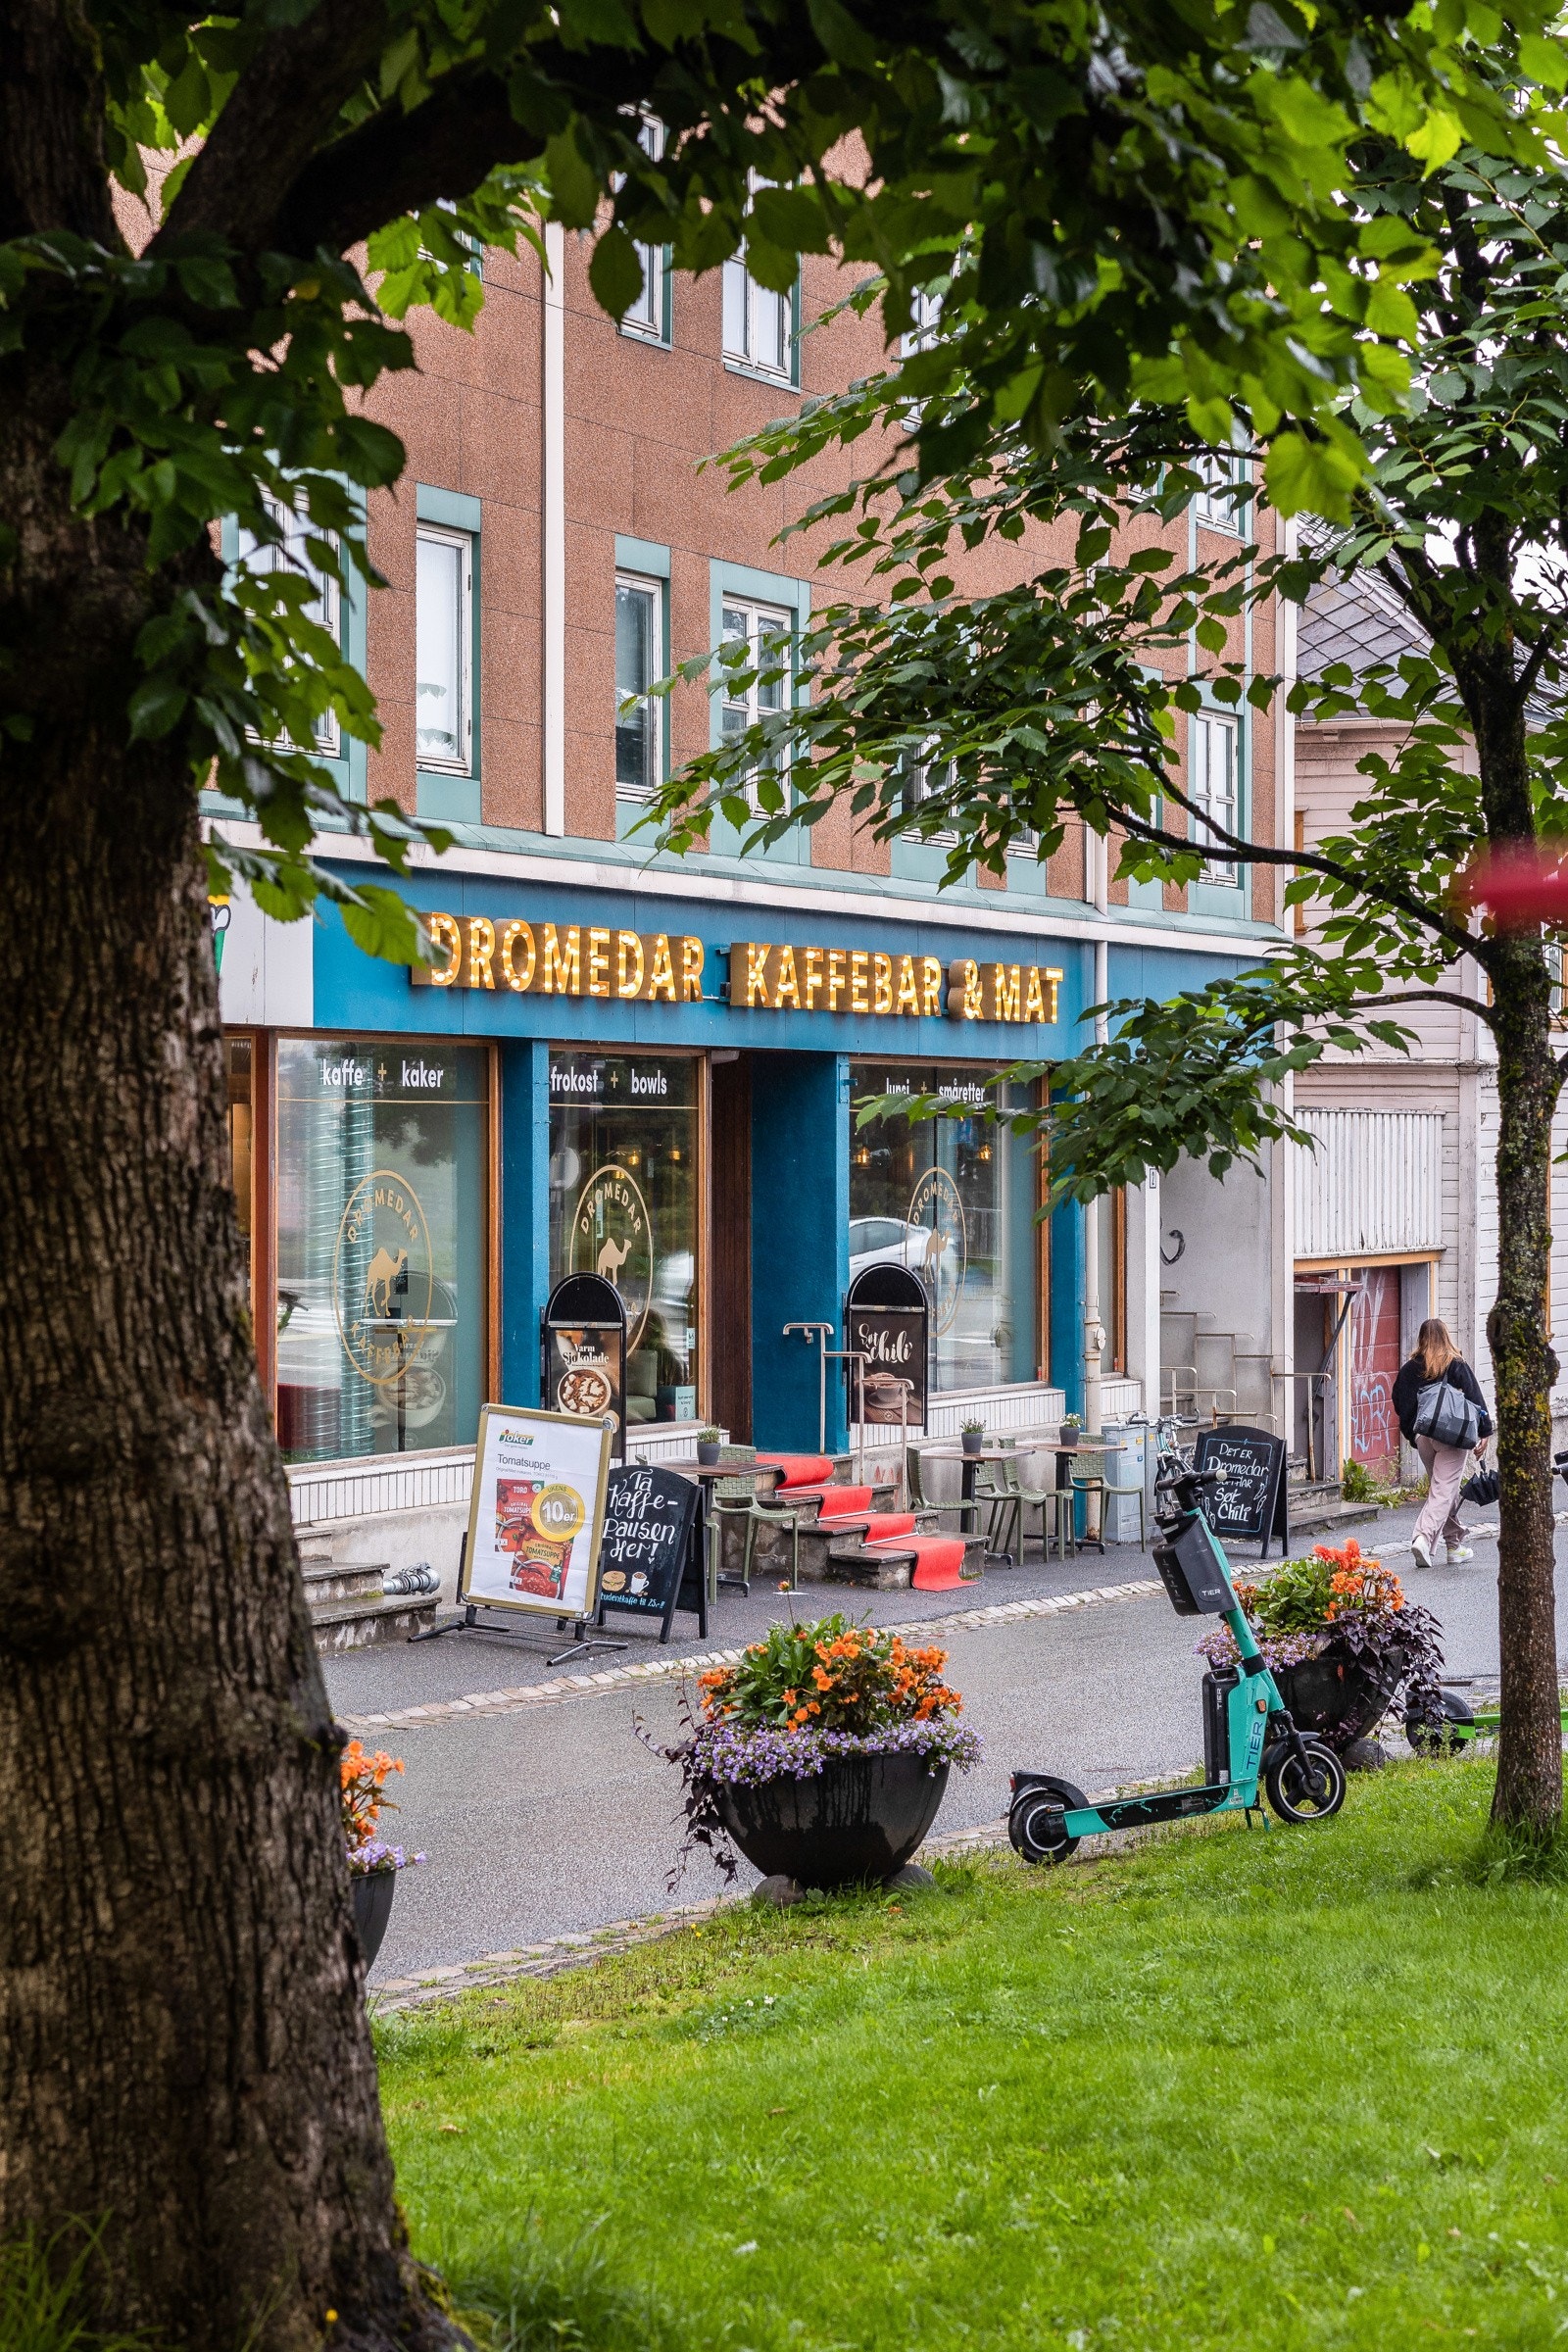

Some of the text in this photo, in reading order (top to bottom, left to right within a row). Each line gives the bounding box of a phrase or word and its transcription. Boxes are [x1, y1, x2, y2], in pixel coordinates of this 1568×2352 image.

[430, 911, 1063, 1024] DROMEDAR KAFFEBAR & MAT
[322, 1058, 364, 1087] kaffe
[402, 1059, 444, 1088] kaker
[550, 1065, 599, 1093] frokost
[630, 1068, 667, 1095] bowls
[938, 1077, 986, 1102] småretter
[347, 1188, 418, 1245] DROMEDAR
[580, 1181, 642, 1236] DROMEDAR
[563, 1351, 610, 1366] Sjokolade
[573, 1343, 596, 1352] Varm
[500, 1429, 533, 1445] joker
[497, 1453, 551, 1471] Tomatsuppe
[1219, 1443, 1252, 1460] DET ER
[1206, 1455, 1269, 1477] Dromedar
[628, 1468, 654, 1493] Ta
[1214, 1487, 1242, 1506] Søt
[542, 1500, 575, 1523] 10er
[1217, 1502, 1252, 1523] Chili
[602, 1517, 676, 1545] Pausen
[525, 1545, 561, 1560] TOMATSUPPE
[600, 1592, 638, 1605] tudentkaffe
[1201, 1588, 1221, 1596] TIER
[1246, 1721, 1263, 1770] TIER
